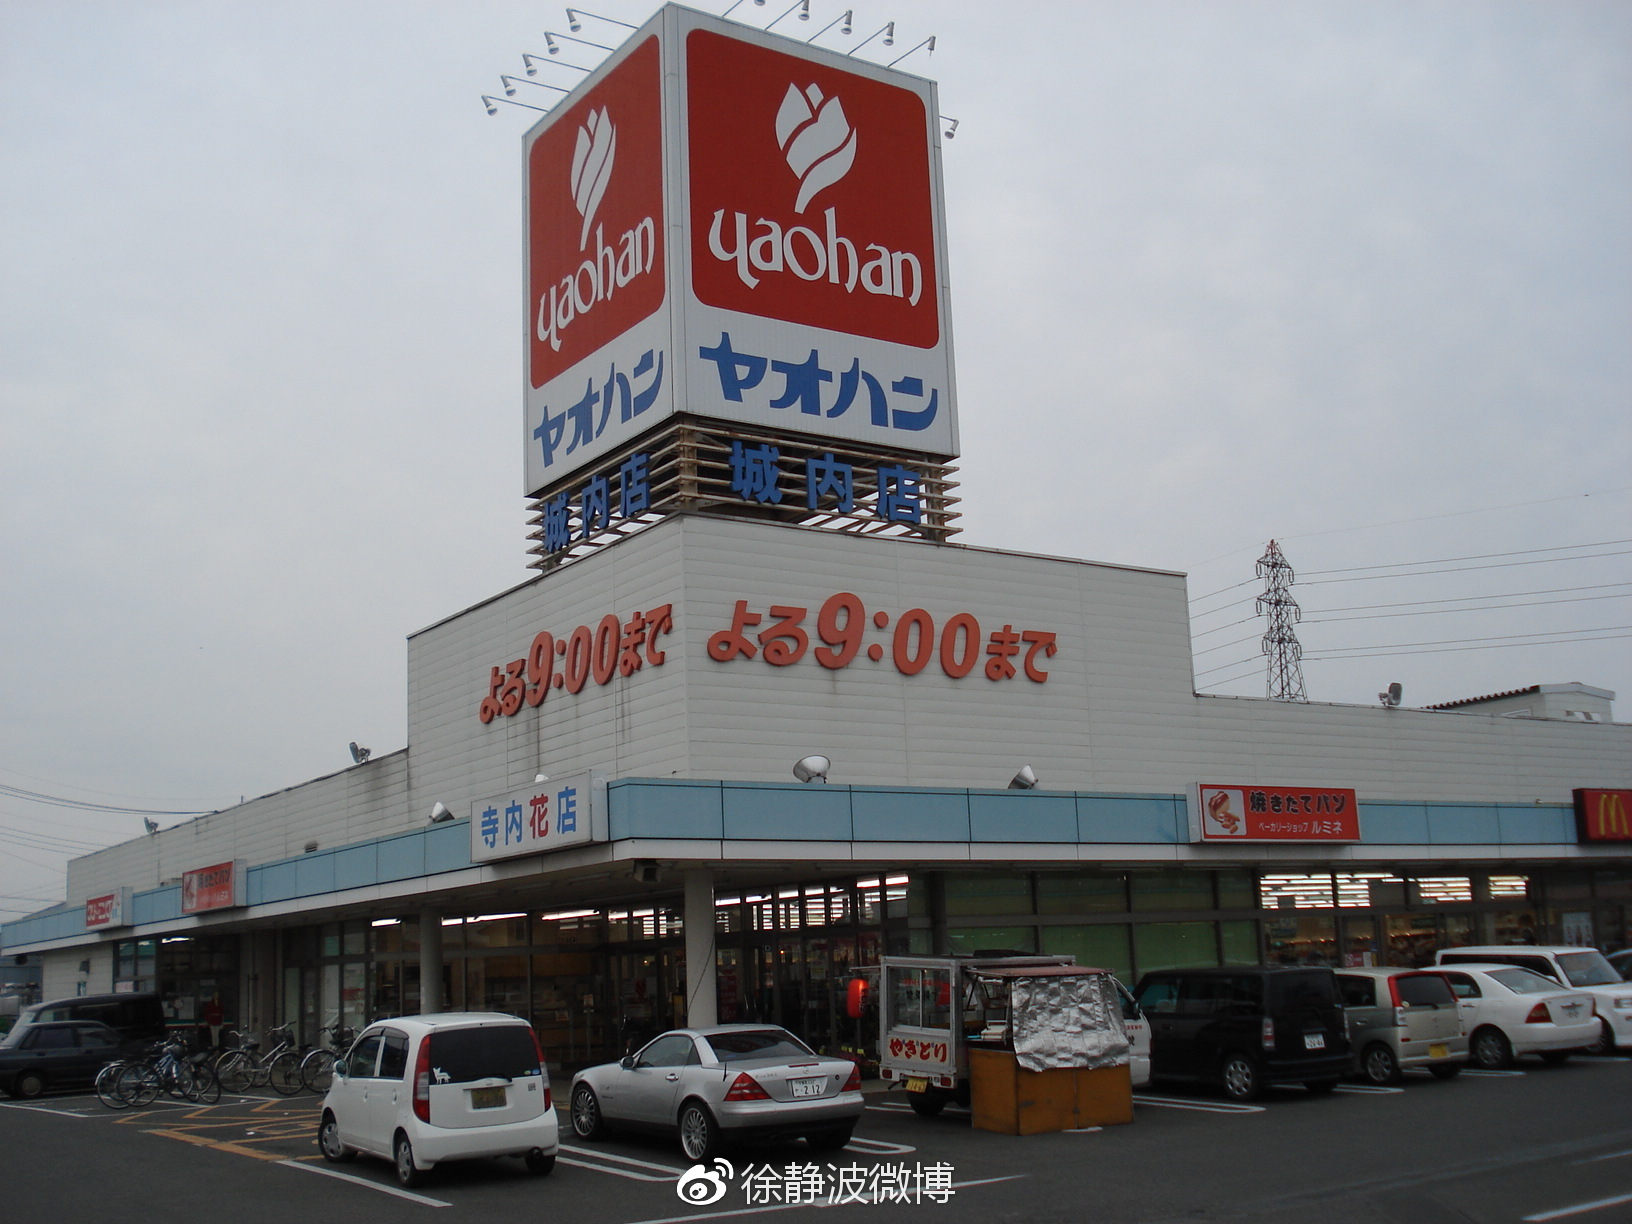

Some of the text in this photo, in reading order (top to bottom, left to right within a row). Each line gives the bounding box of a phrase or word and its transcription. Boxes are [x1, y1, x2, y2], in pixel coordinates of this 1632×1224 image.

[536, 216, 655, 352] yaohan
[707, 206, 922, 307] yaohan
[533, 348, 664, 469] ヤオハン
[699, 331, 938, 431] ヤオハン
[543, 453, 651, 553] 城内店
[729, 440, 922, 526] 城内店
[479, 602, 673, 725] よる9:00まで
[706, 592, 1057, 683] よる9:00まで
[480, 785, 578, 849] 寺内花店
[1249, 789, 1347, 815] 焼きたてパン
[1258, 820, 1343, 835] ベーカリーショップ ルミネ
[889, 1038, 947, 1063] やきとり
